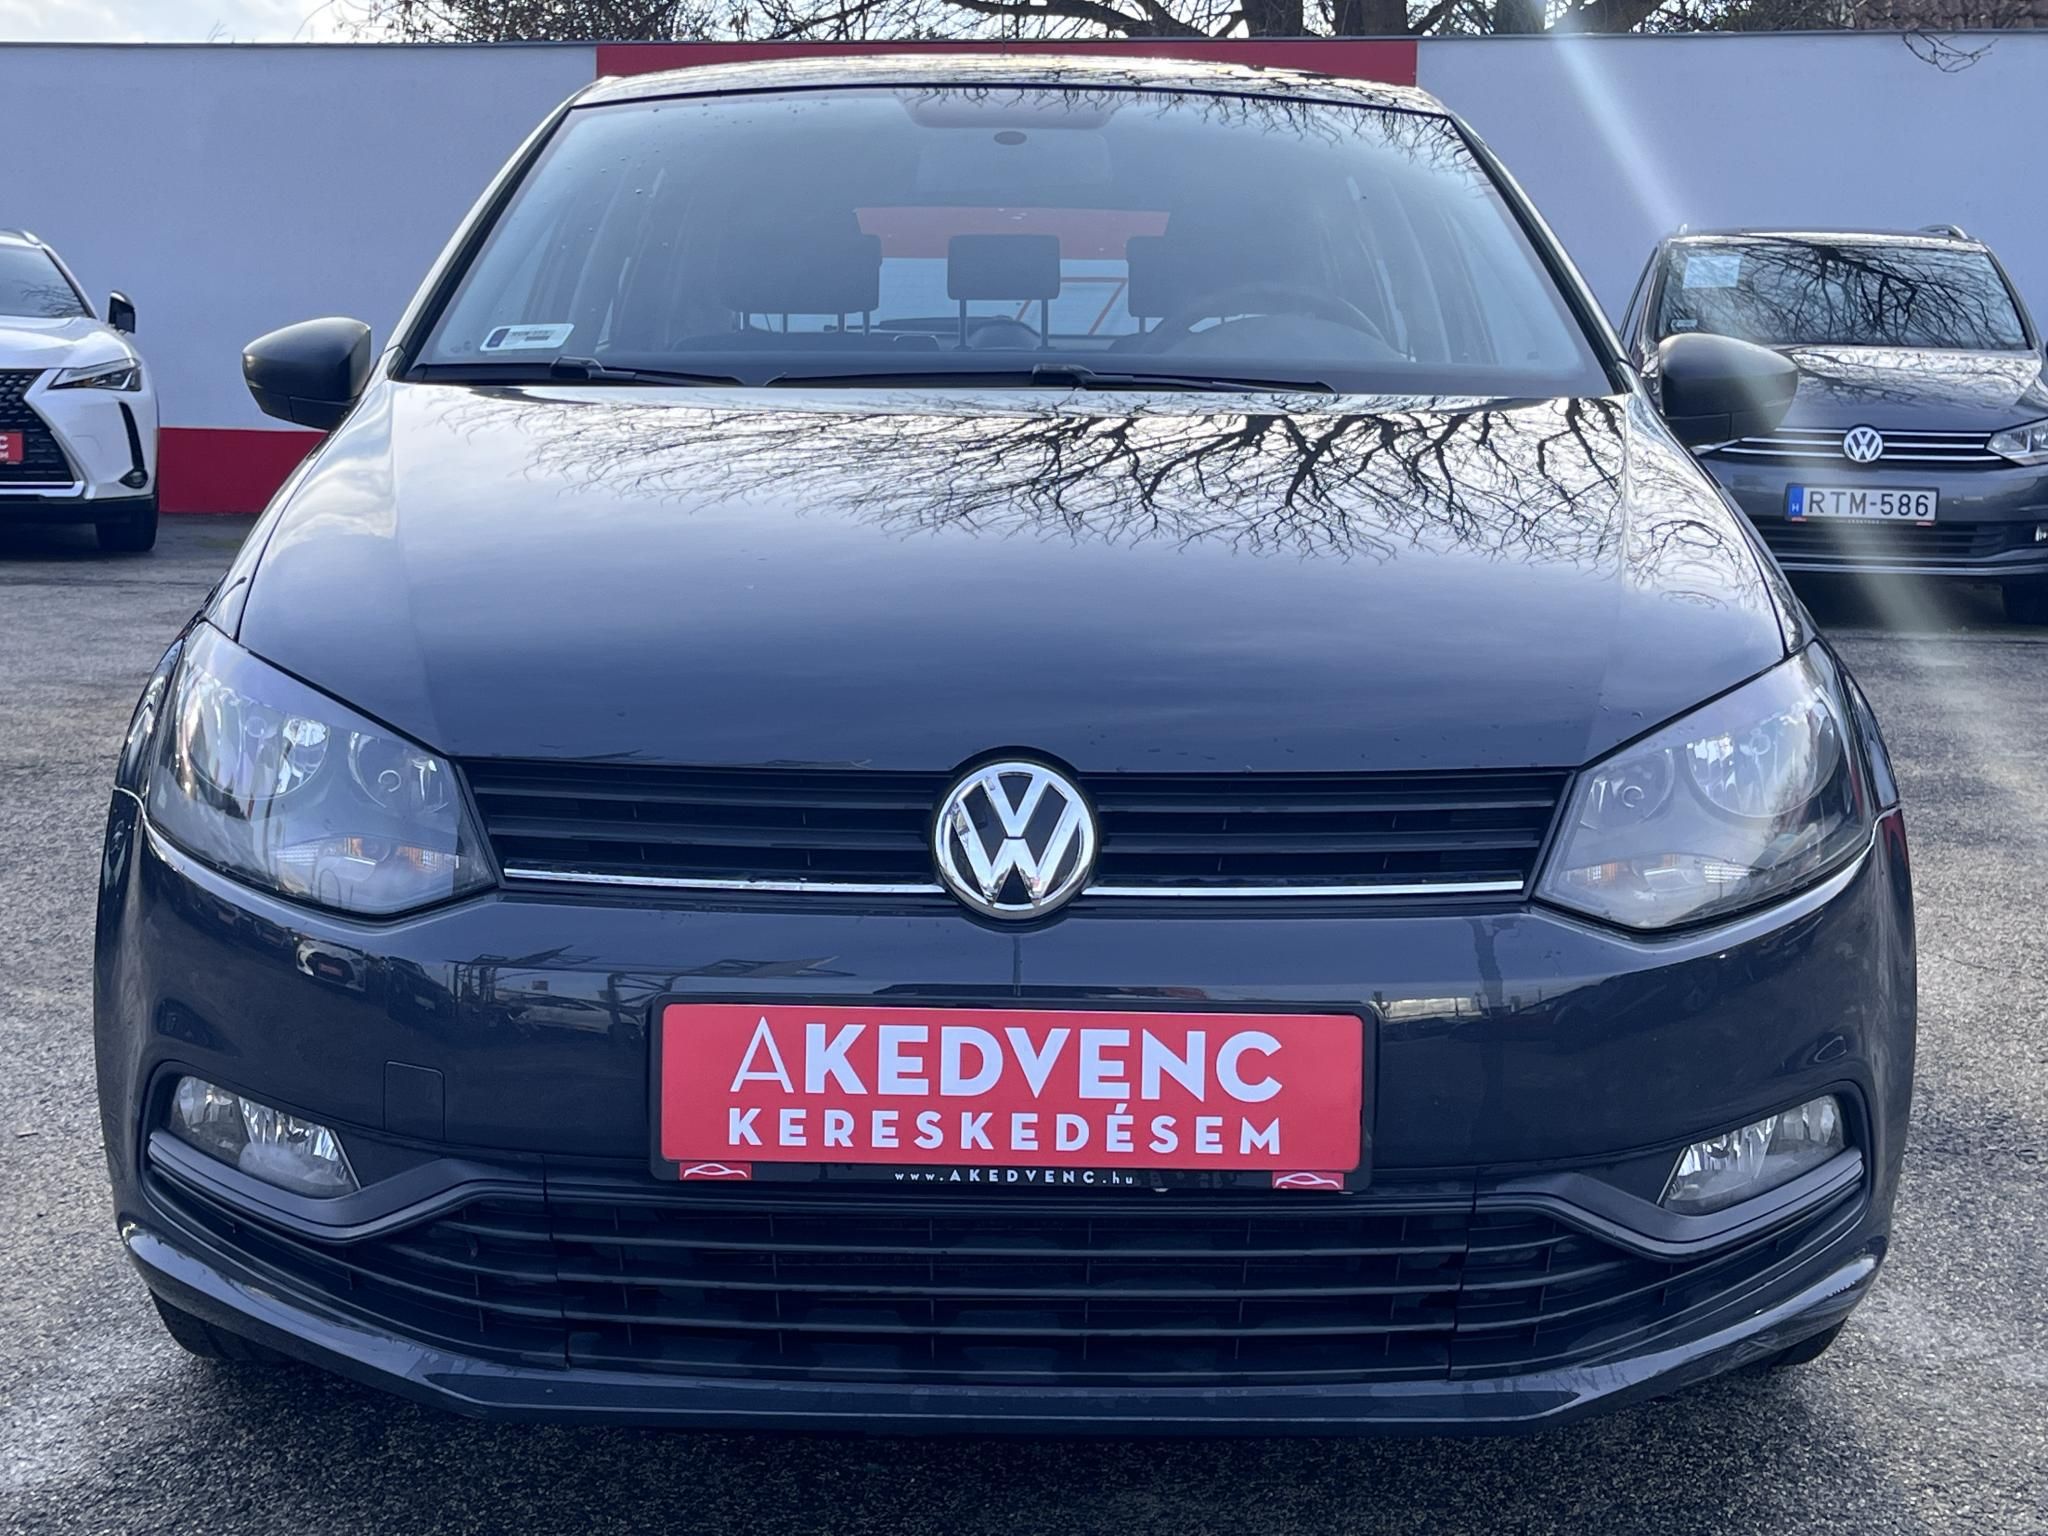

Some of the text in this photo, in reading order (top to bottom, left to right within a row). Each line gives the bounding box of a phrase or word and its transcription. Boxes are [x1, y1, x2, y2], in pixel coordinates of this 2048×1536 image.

[1844, 427, 1884, 463] VW
[1792, 503, 1801, 513] H
[1809, 491, 1930, 516] RTM-586
[935, 762, 1095, 917] VW
[729, 1016, 1283, 1102] AKEDVENC
[728, 1102, 1281, 1155] KERESKEDÉSEM
[894, 1169, 1134, 1184] www.AKEDVENC.hu
